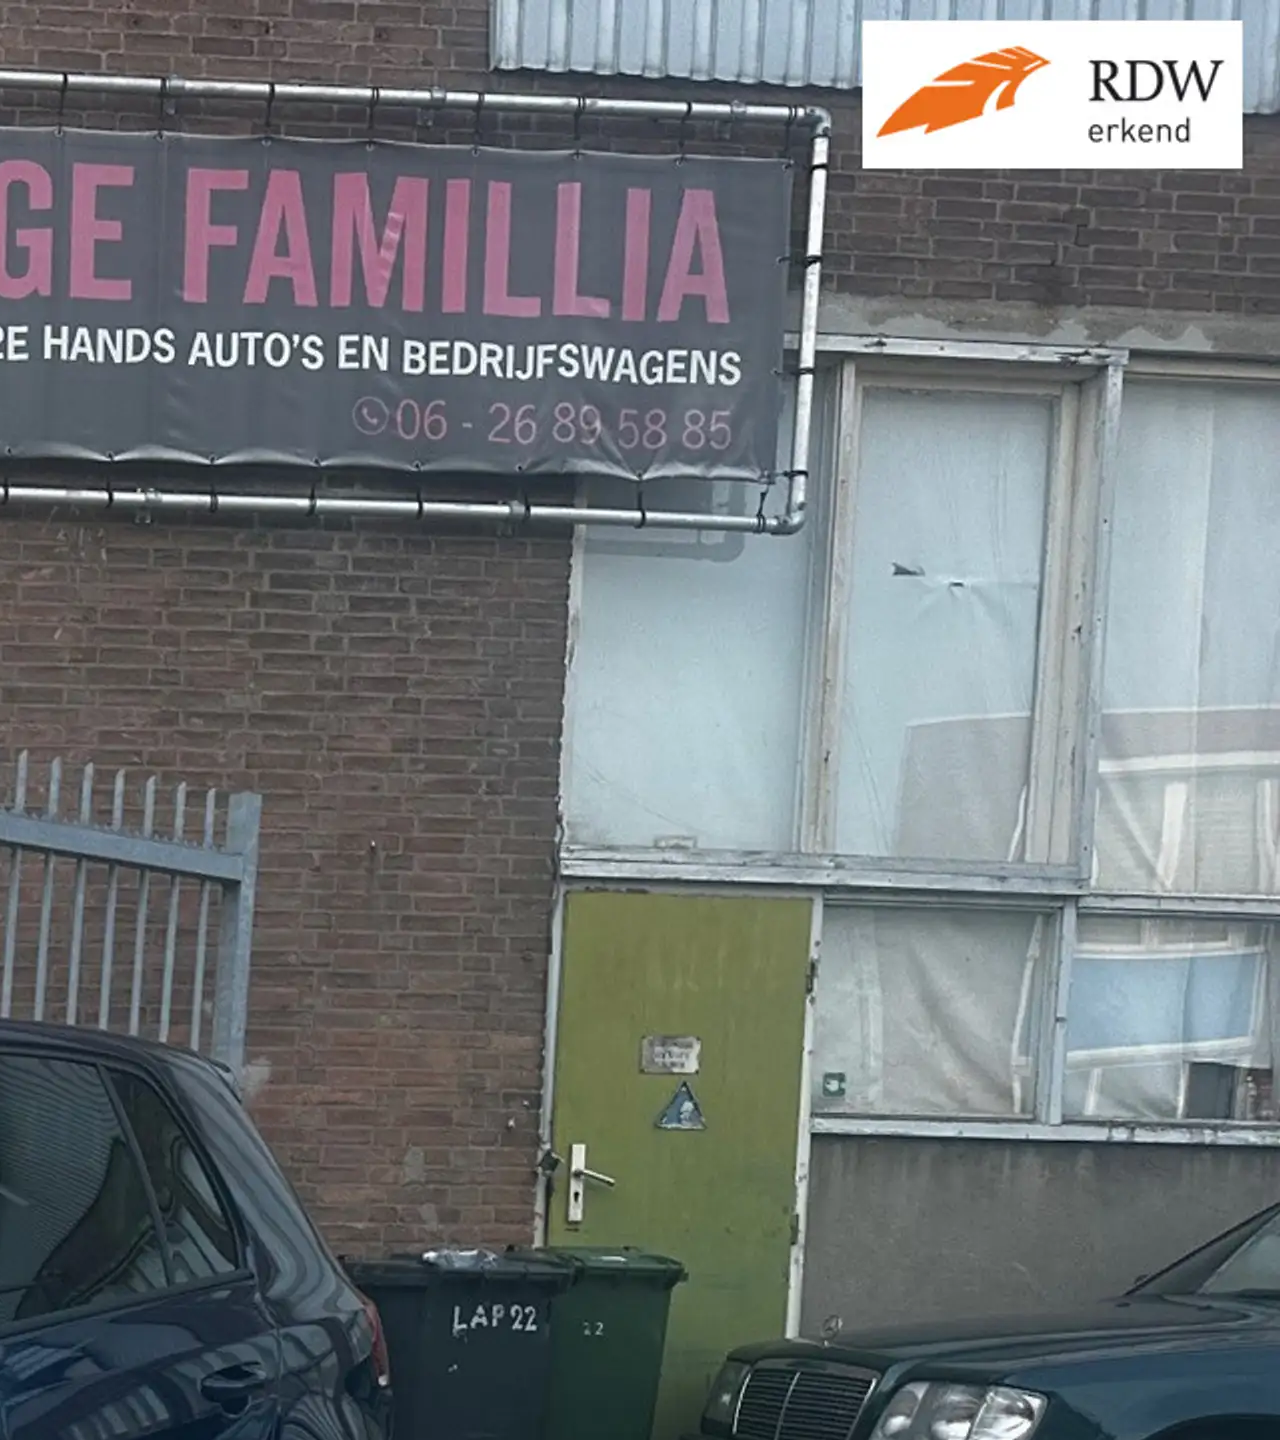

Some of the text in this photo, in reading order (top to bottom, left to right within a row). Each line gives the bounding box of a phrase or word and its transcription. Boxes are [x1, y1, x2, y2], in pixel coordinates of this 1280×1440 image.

[182, 167, 731, 324] FAMILLIA
[43, 324, 176, 364] HANDS
[187, 331, 325, 371] AUTO'S
[338, 334, 389, 372] EN
[402, 338, 742, 387] BEDRIJFSWAGENS
[395, 399, 448, 441] 06
[487, 402, 537, 445] 26
[552, 402, 603, 445] 89
[618, 408, 667, 450] 58
[681, 409, 733, 450] 85
[452, 1304, 538, 1332] LAP 22
